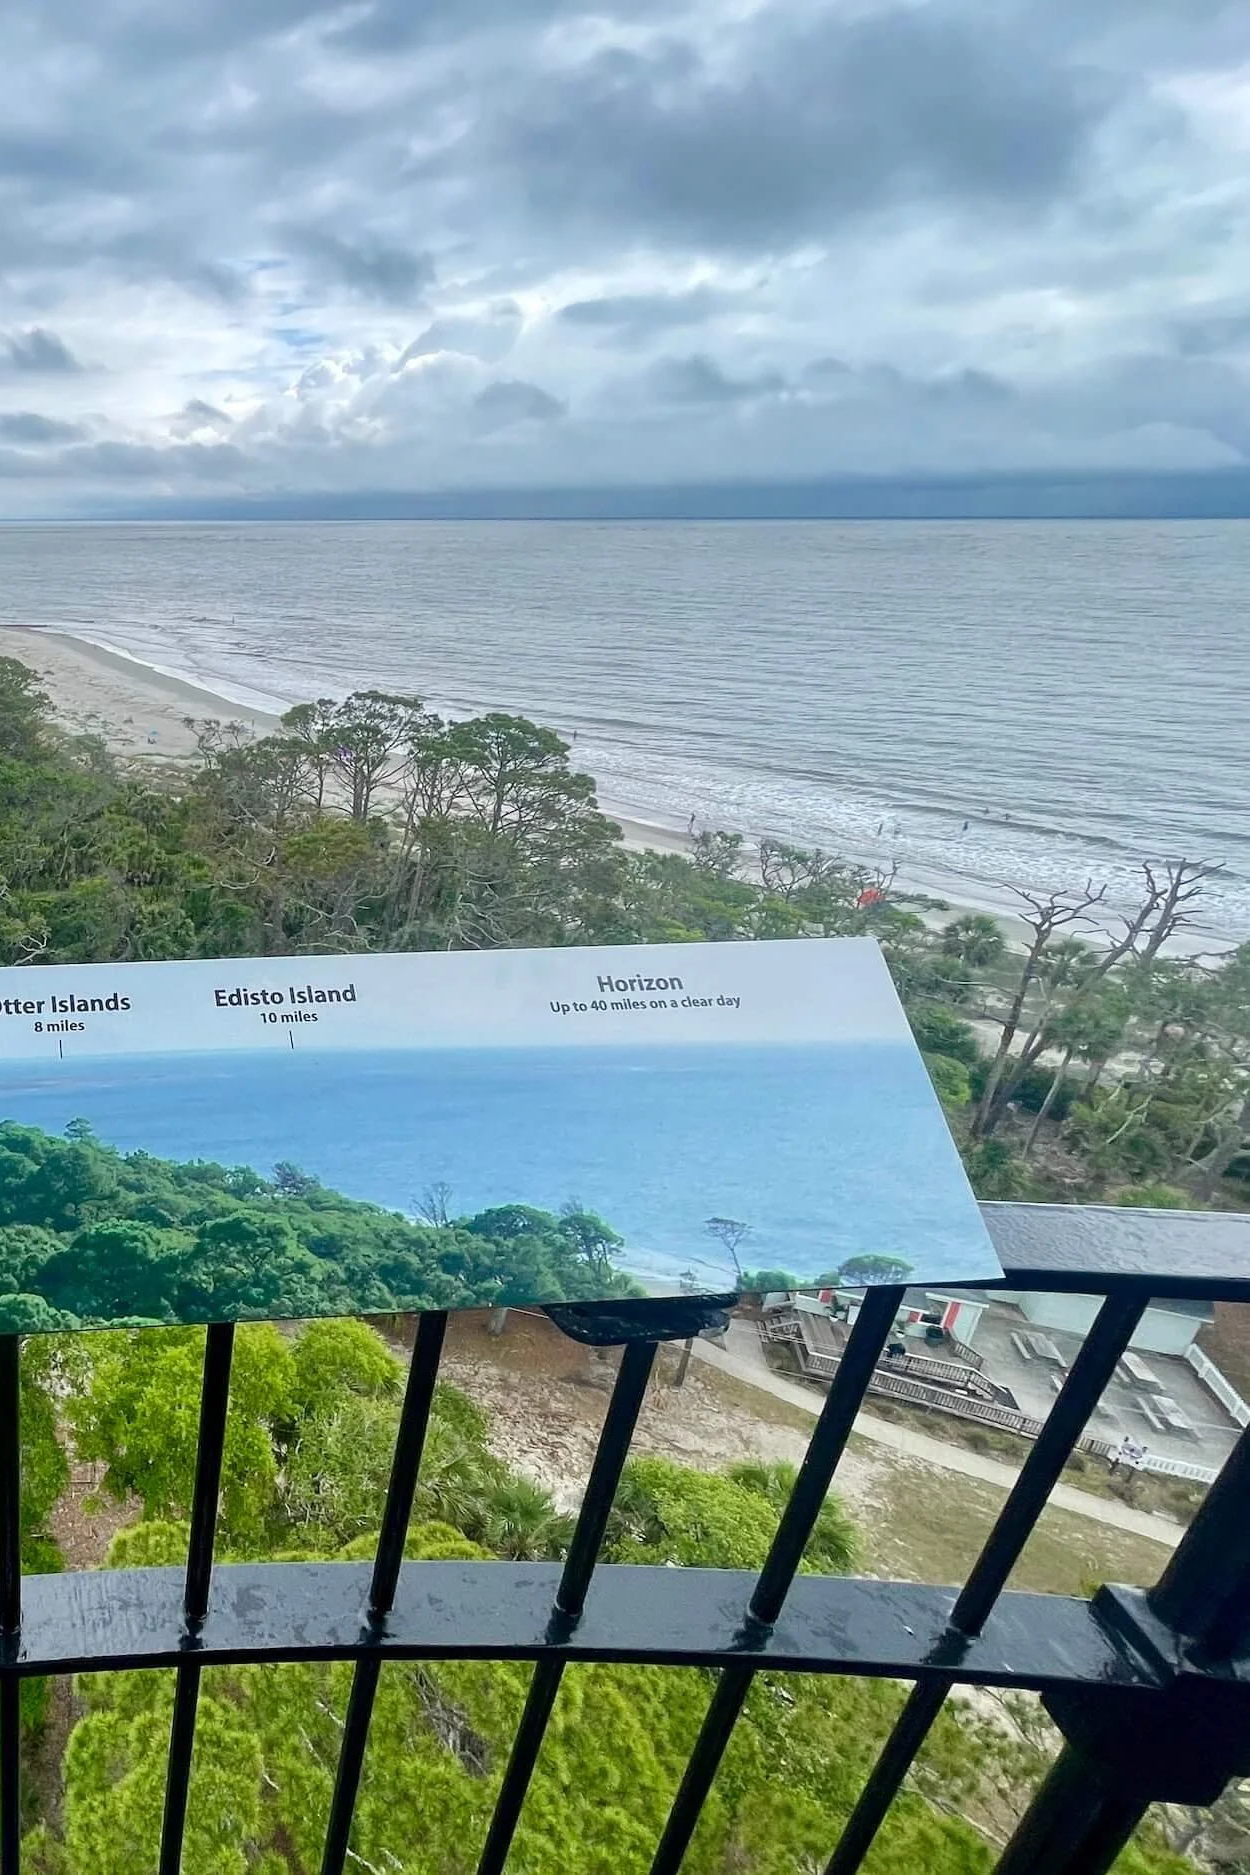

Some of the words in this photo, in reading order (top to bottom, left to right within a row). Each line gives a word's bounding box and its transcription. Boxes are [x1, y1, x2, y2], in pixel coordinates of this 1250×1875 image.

[596, 973, 684, 993] Horizon
[51, 992, 131, 1014] Islands
[213, 987, 284, 1008] Edisto
[289, 983, 357, 1005] Island
[550, 1000, 570, 1015] Up
[572, 1000, 587, 1012] to
[590, 999, 608, 1012] 40
[610, 997, 646, 1011] miles
[649, 999, 667, 1010] on
[669, 998, 678, 1009] a
[681, 995, 713, 1009] clear
[715, 994, 741, 1010] day
[34, 1021, 43, 1032] 8
[46, 1019, 85, 1032] miles
[260, 1011, 277, 1024] 10
[280, 1010, 318, 1023] miles
